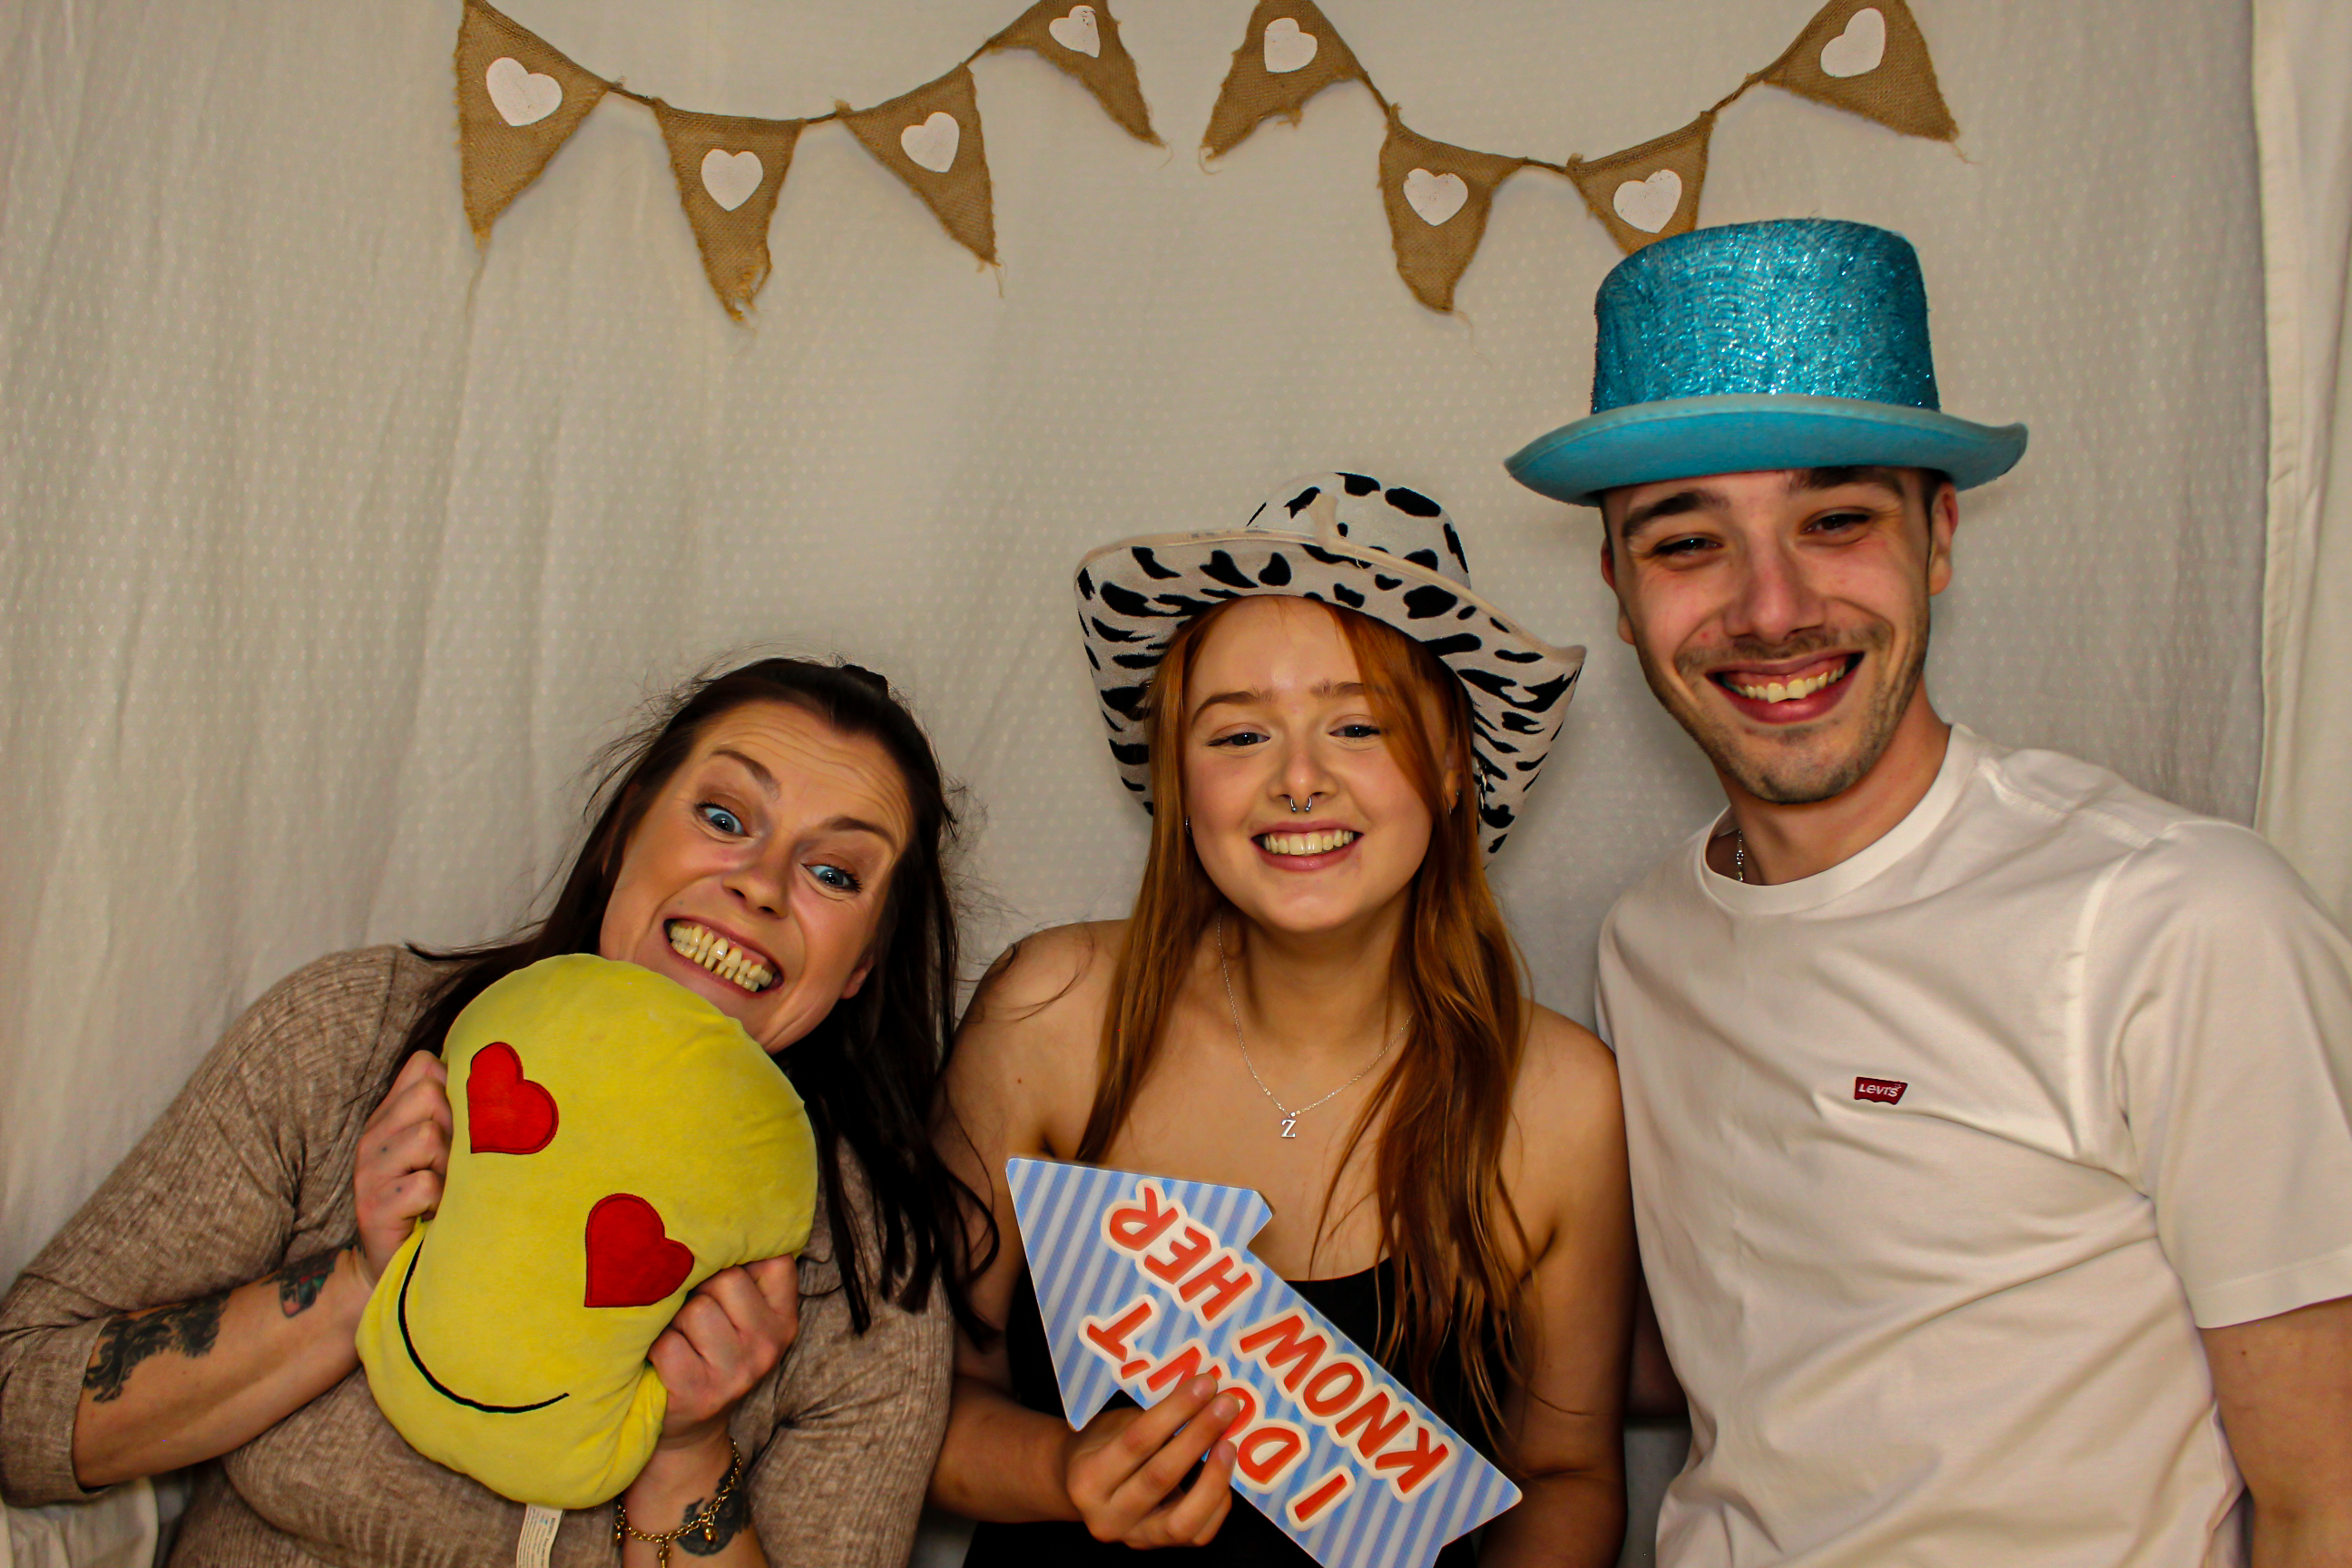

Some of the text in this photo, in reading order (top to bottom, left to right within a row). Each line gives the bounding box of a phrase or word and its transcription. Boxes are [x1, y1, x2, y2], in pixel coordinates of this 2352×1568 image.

[1280, 1119, 1296, 1138] Z
[1110, 1187, 1449, 1494] KNOW HER
[1294, 1474, 1348, 1522] I
